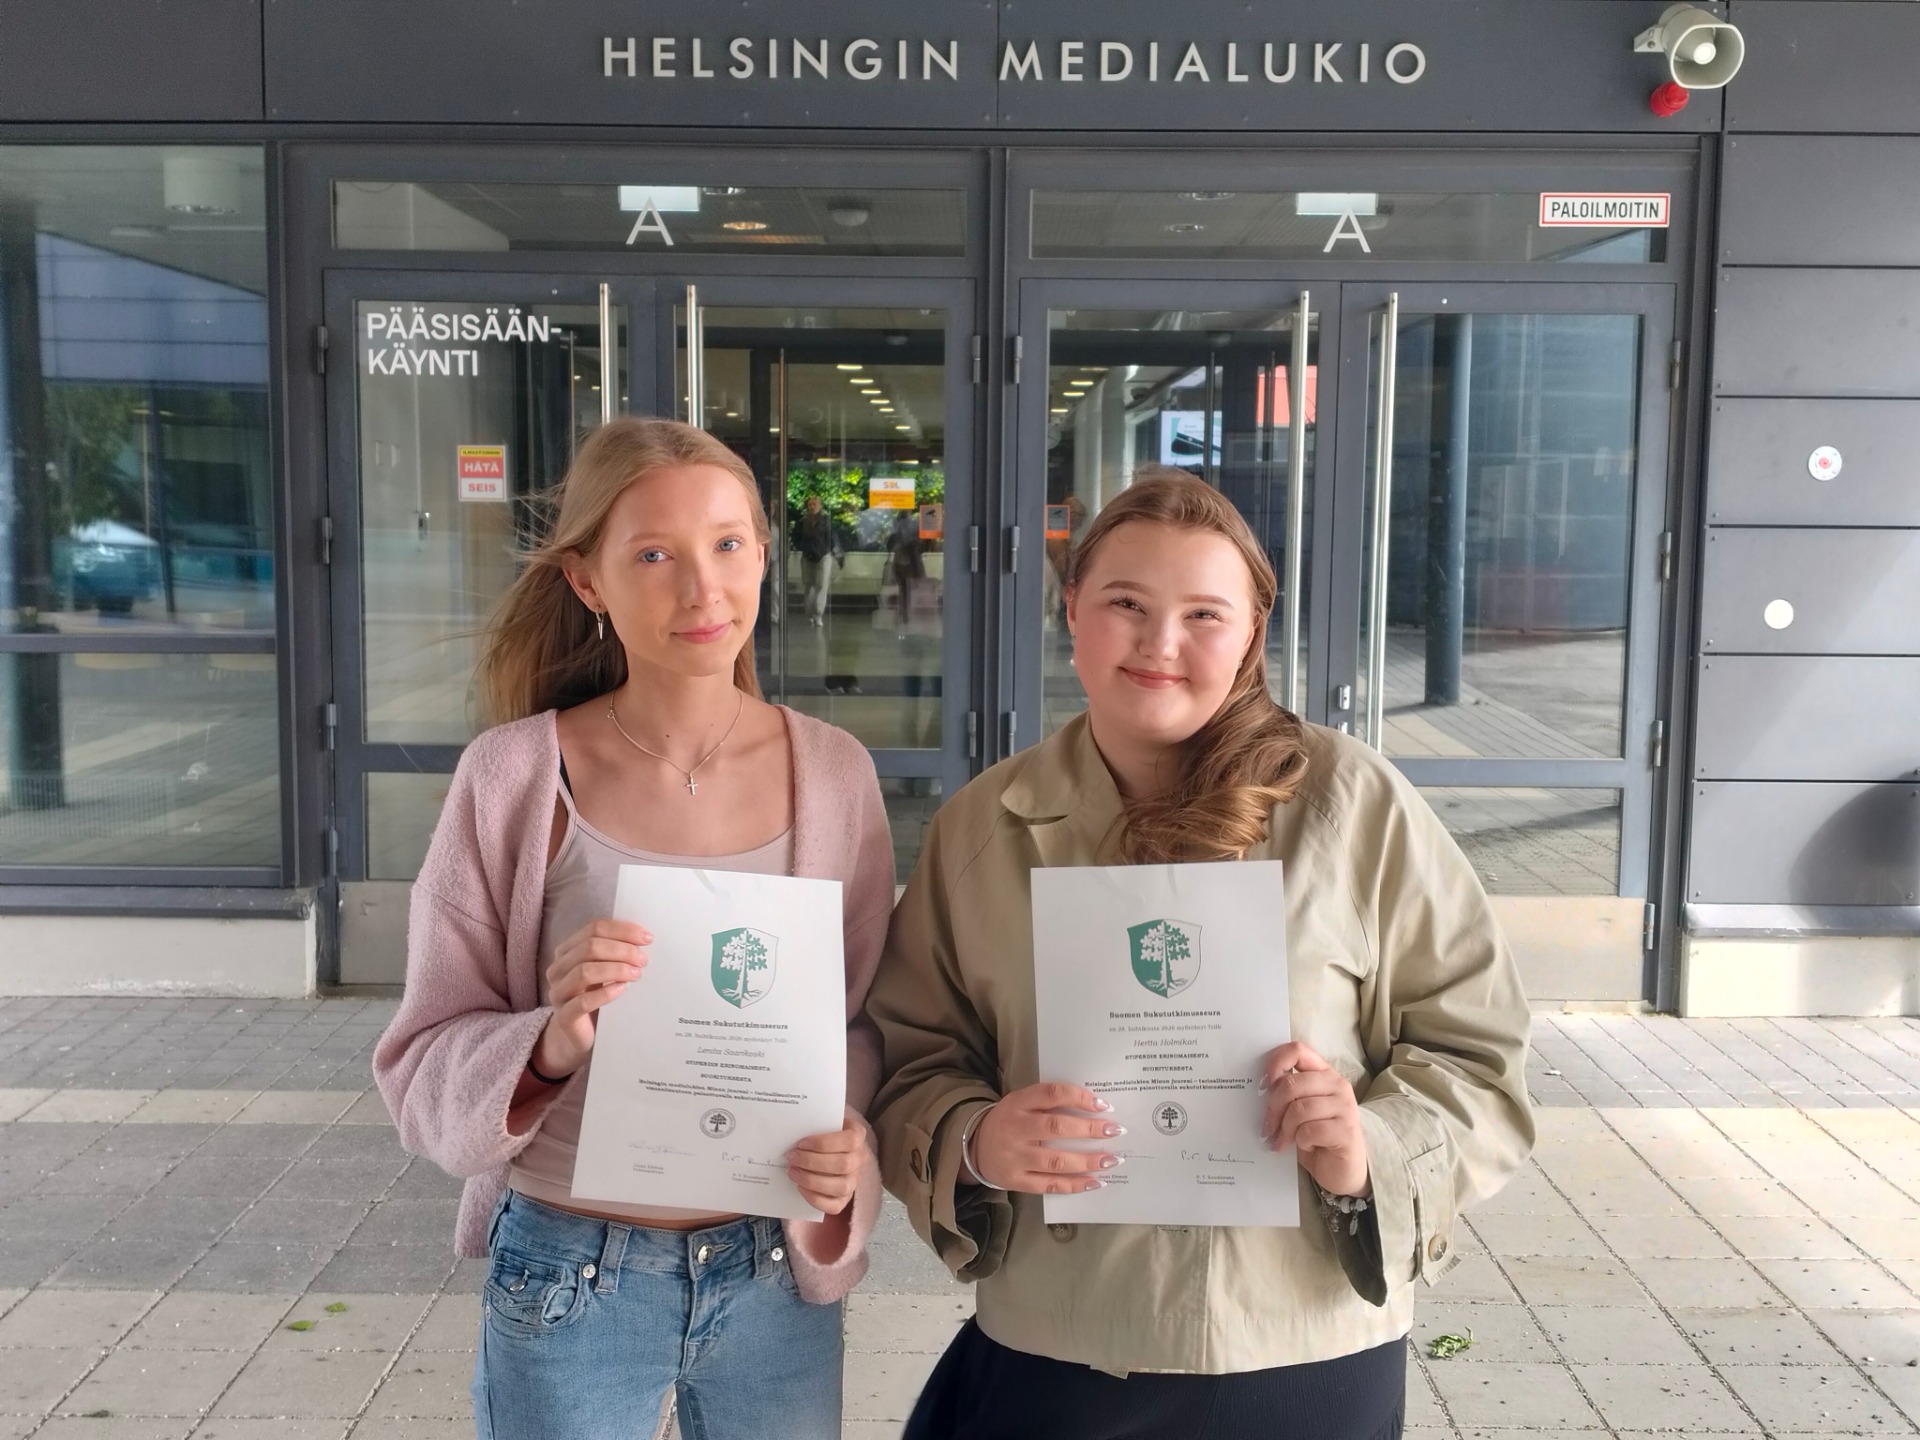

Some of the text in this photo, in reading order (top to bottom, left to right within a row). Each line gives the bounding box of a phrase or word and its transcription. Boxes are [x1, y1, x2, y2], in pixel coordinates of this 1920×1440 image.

[603, 37, 1427, 84] HELSINGIN MEDIALUKIO
[1551, 201, 1659, 219] PALOILMOITIN
[625, 196, 674, 246] A
[1323, 207, 1371, 253] A
[367, 306, 562, 342] PÄÄSISÄÄN-
[368, 342, 478, 376] KÄYNTI
[464, 460, 500, 473] HÄTÄ
[468, 483, 496, 493] SEIS
[883, 481, 900, 489] SOL
[1109, 1010, 1221, 1019] Suomen Sukututkimusseura
[678, 1017, 788, 1030] Suomen Sukututkimusseura
[1133, 1038, 1198, 1047] Hertta Holmikari
[1084, 1080, 1112, 1088] Helsingin
[1171, 1077, 1193, 1085] juureni
